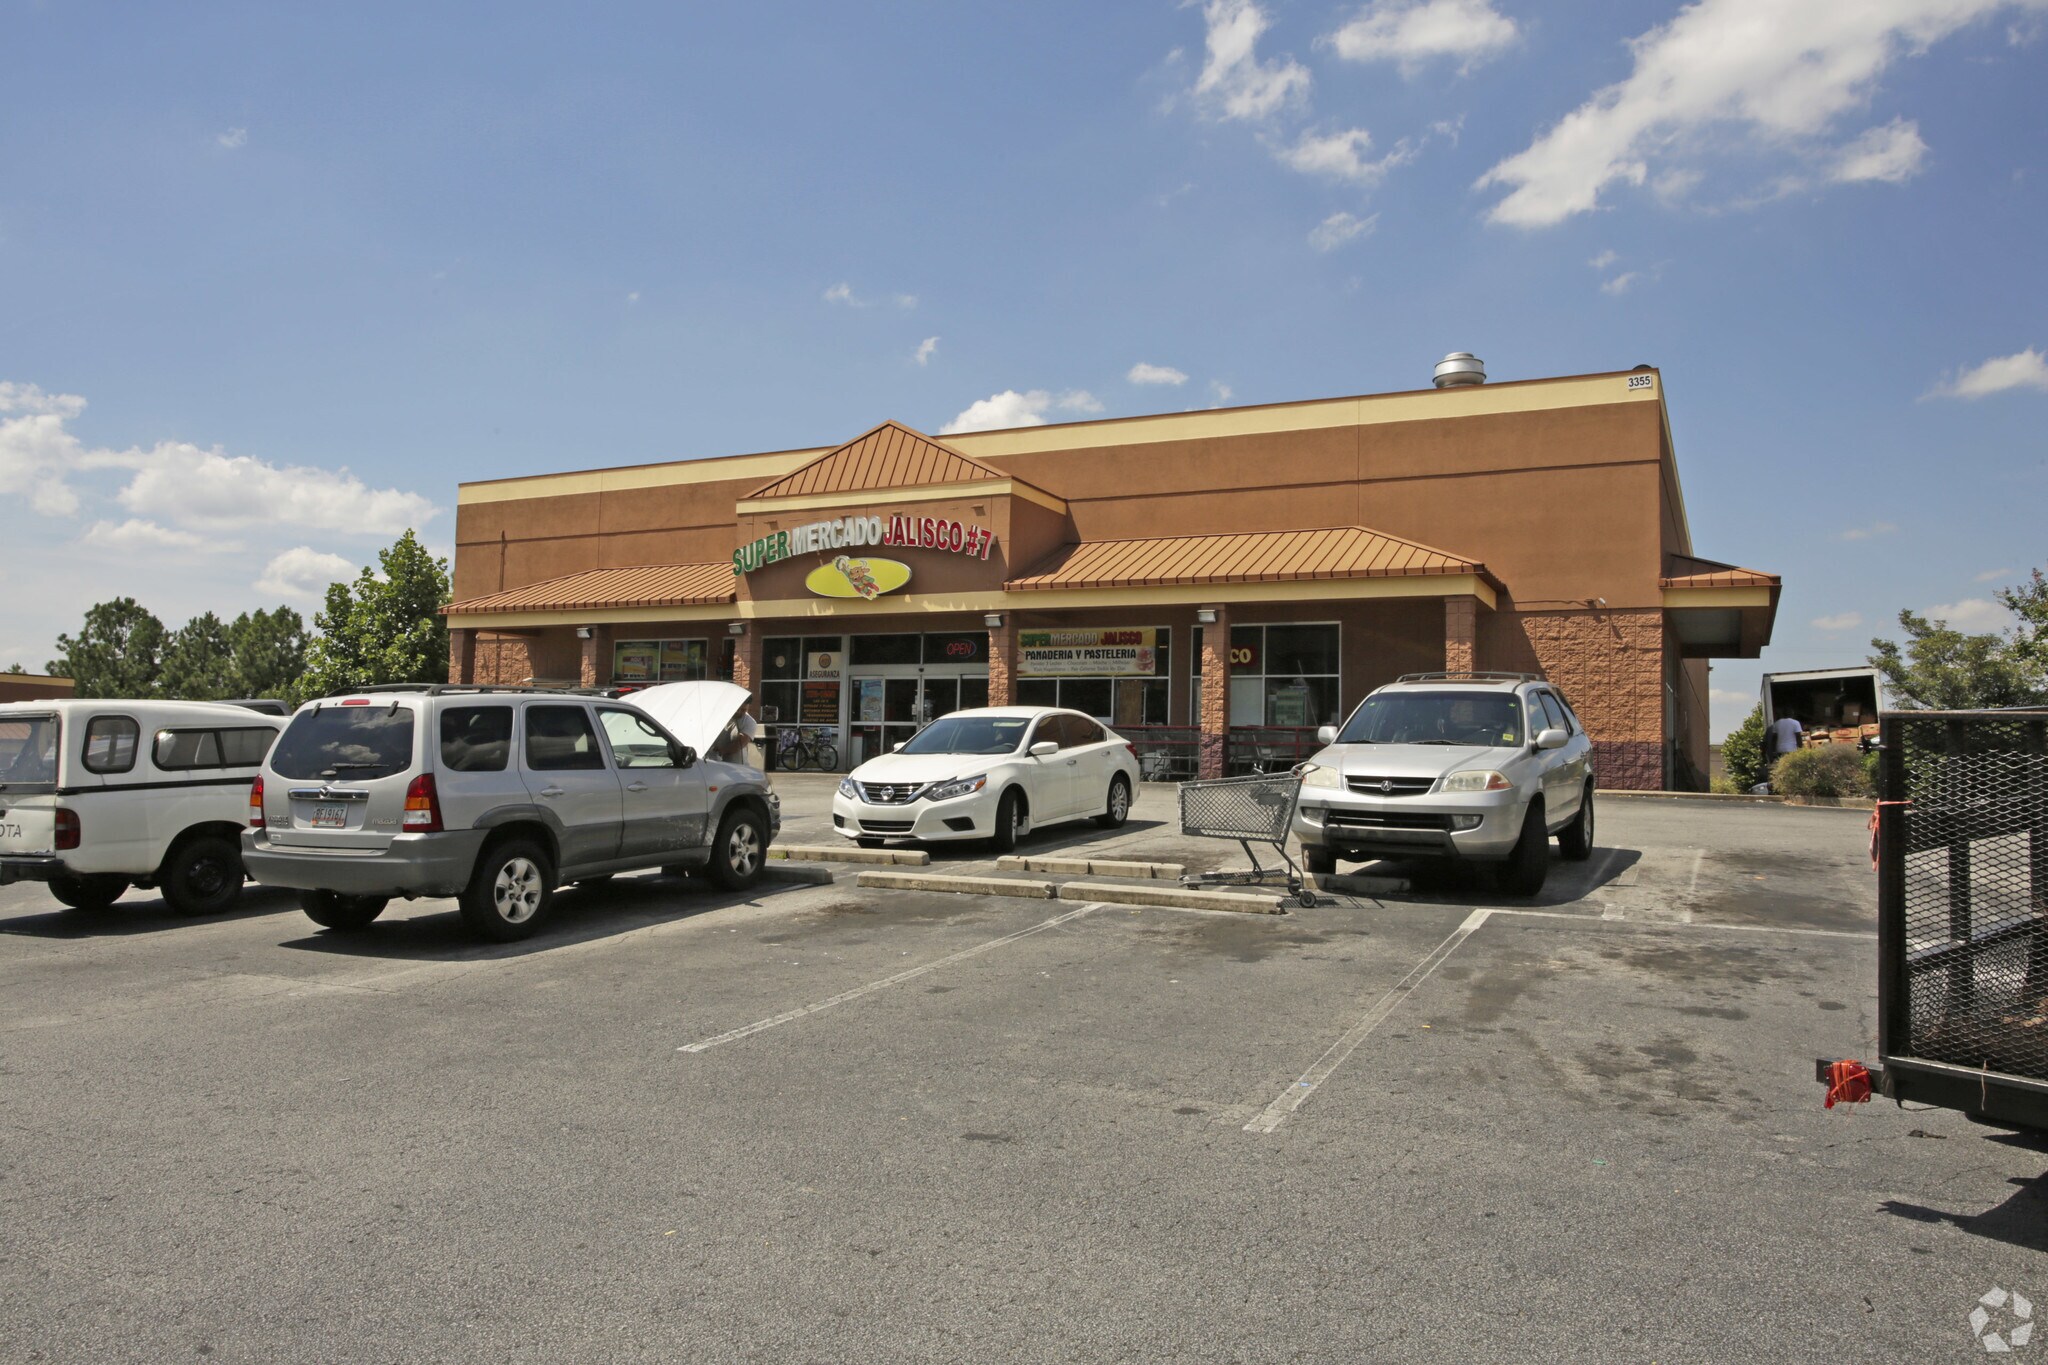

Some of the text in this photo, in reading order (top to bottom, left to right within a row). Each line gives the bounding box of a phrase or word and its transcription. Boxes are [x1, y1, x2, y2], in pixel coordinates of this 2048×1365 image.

[1628, 376, 1651, 387] 3355
[733, 531, 791, 576] SUPER
[792, 515, 883, 556] MERCADO
[883, 515, 964, 553] JALISCO
[1050, 632, 1099, 646] MERCADO
[1101, 631, 1143, 646] JALISCO
[947, 642, 972, 655] OPEN
[1025, 648, 1137, 661] PANADERIA Y PASTELERIA
[809, 670, 840, 679] ASEGURANZA
